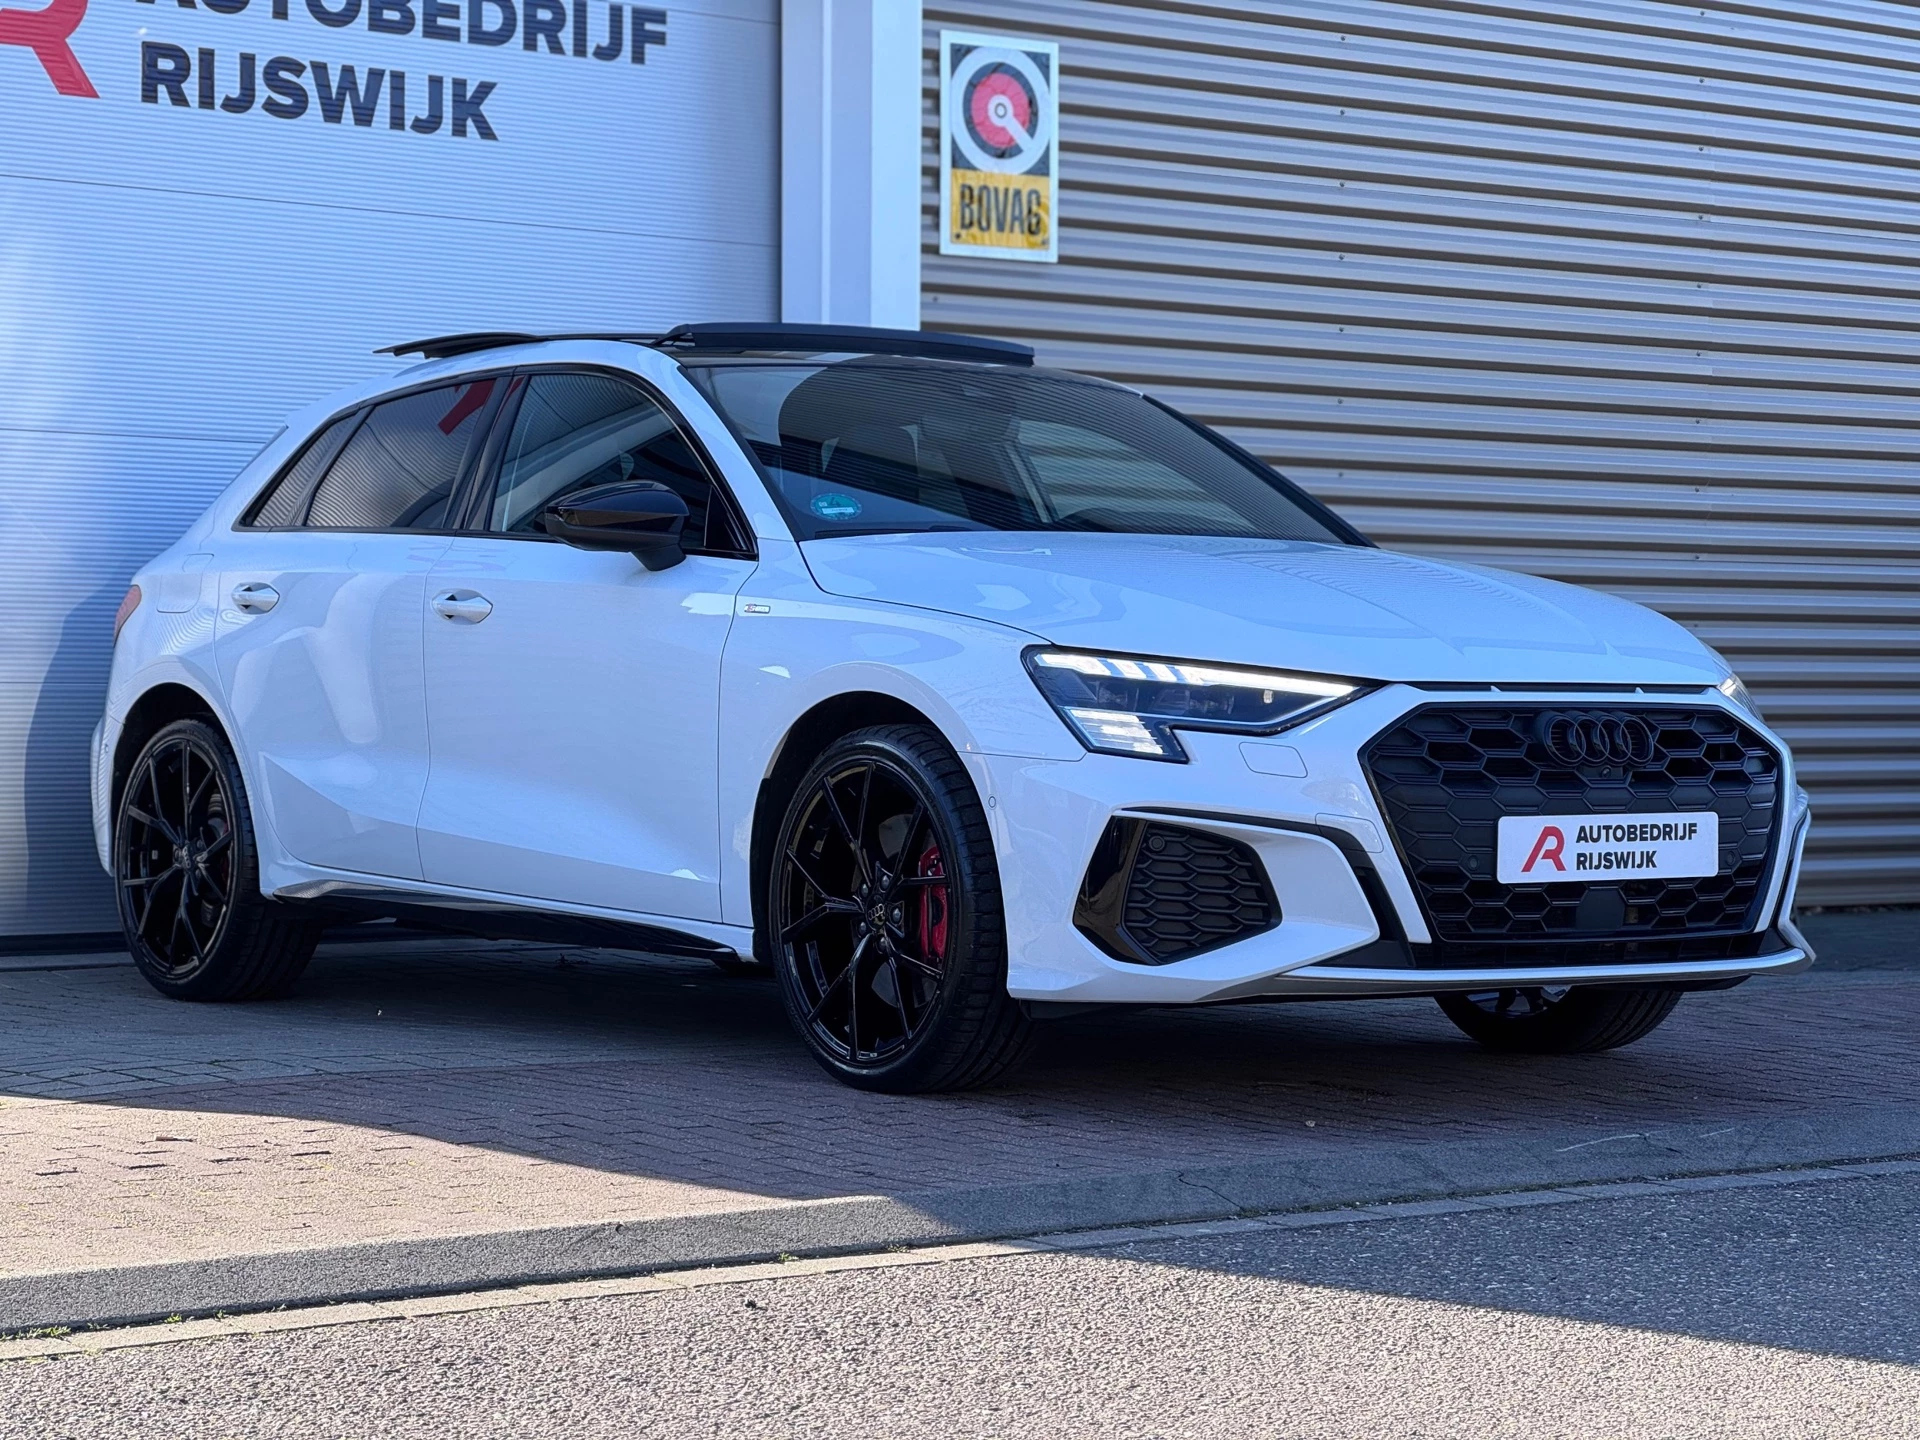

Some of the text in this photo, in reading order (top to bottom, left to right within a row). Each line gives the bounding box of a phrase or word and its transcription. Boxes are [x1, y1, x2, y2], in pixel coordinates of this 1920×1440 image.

[135, 0, 667, 65] BEDRIJF
[141, 41, 498, 141] RIJSWIJK
[960, 184, 1041, 236] BOVAG
[1576, 823, 1698, 843] AUTOBEDRIJF
[1576, 850, 1658, 871] RIJSWIJK
